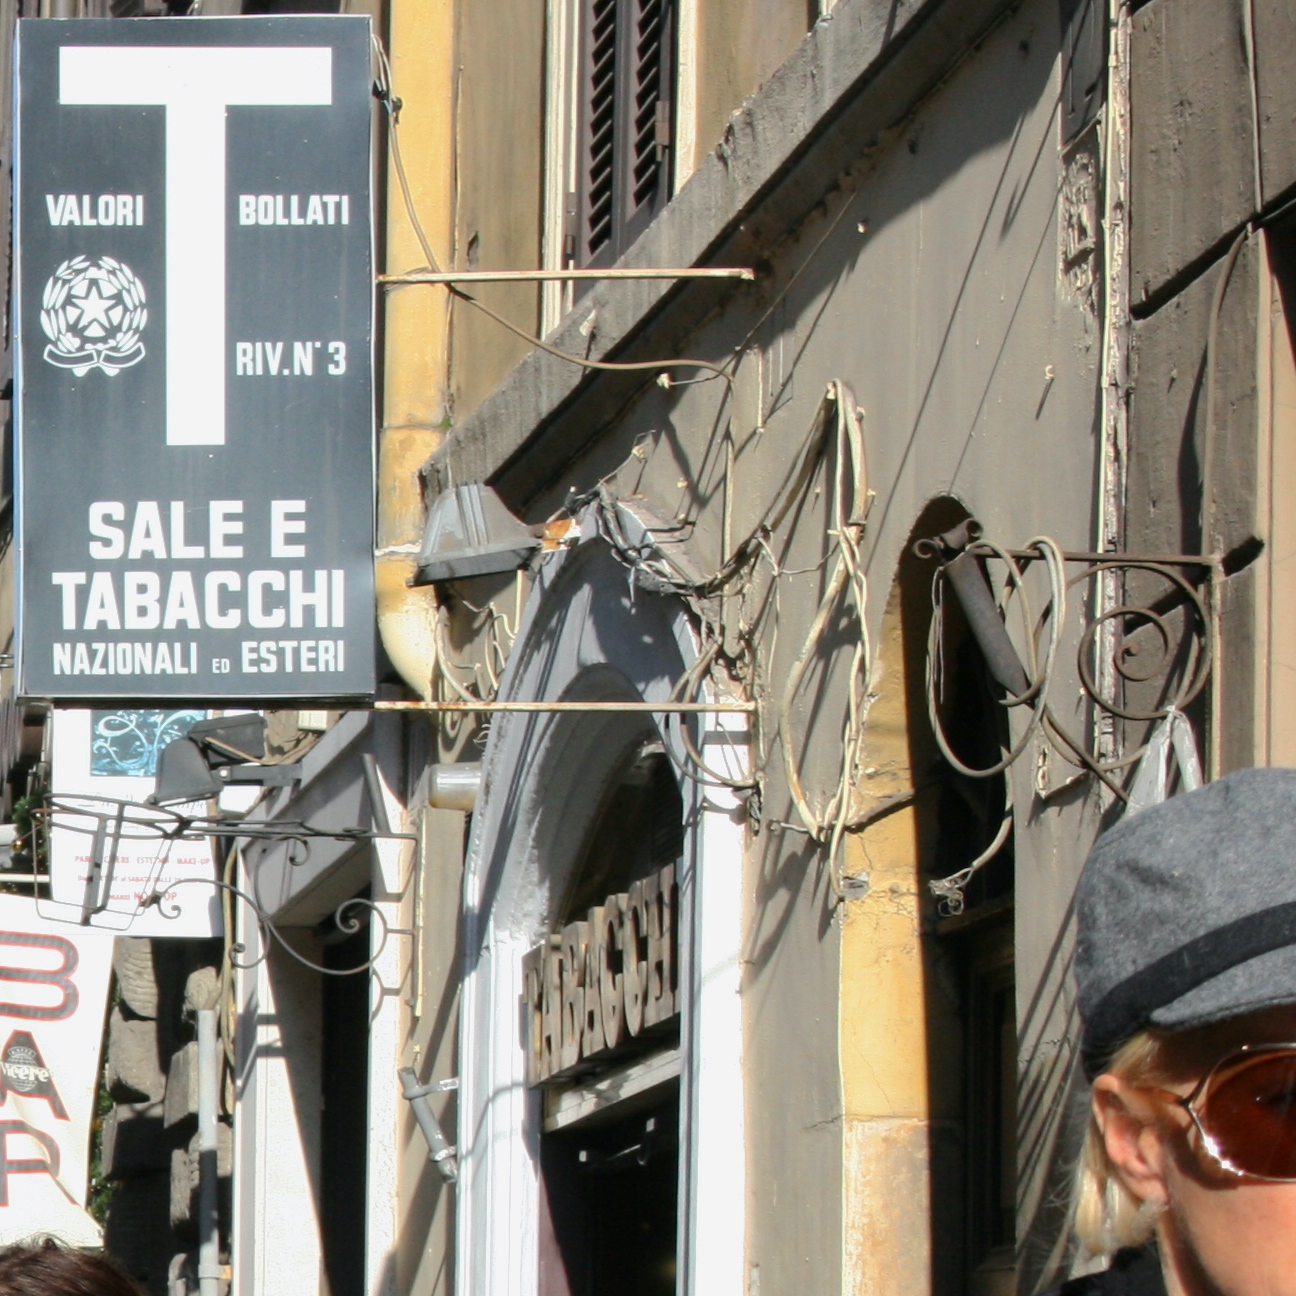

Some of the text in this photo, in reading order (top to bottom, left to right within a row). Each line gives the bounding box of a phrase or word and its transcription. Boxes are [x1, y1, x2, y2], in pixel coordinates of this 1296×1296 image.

[46, 194, 144, 227] VALORI
[238, 194, 349, 227] BOLLATI
[59, 46, 332, 445] T
[88, 500, 307, 560] SALE E
[52, 569, 345, 630] TABACCHI
[53, 639, 345, 675] NAZIONALI ED ESTERI
